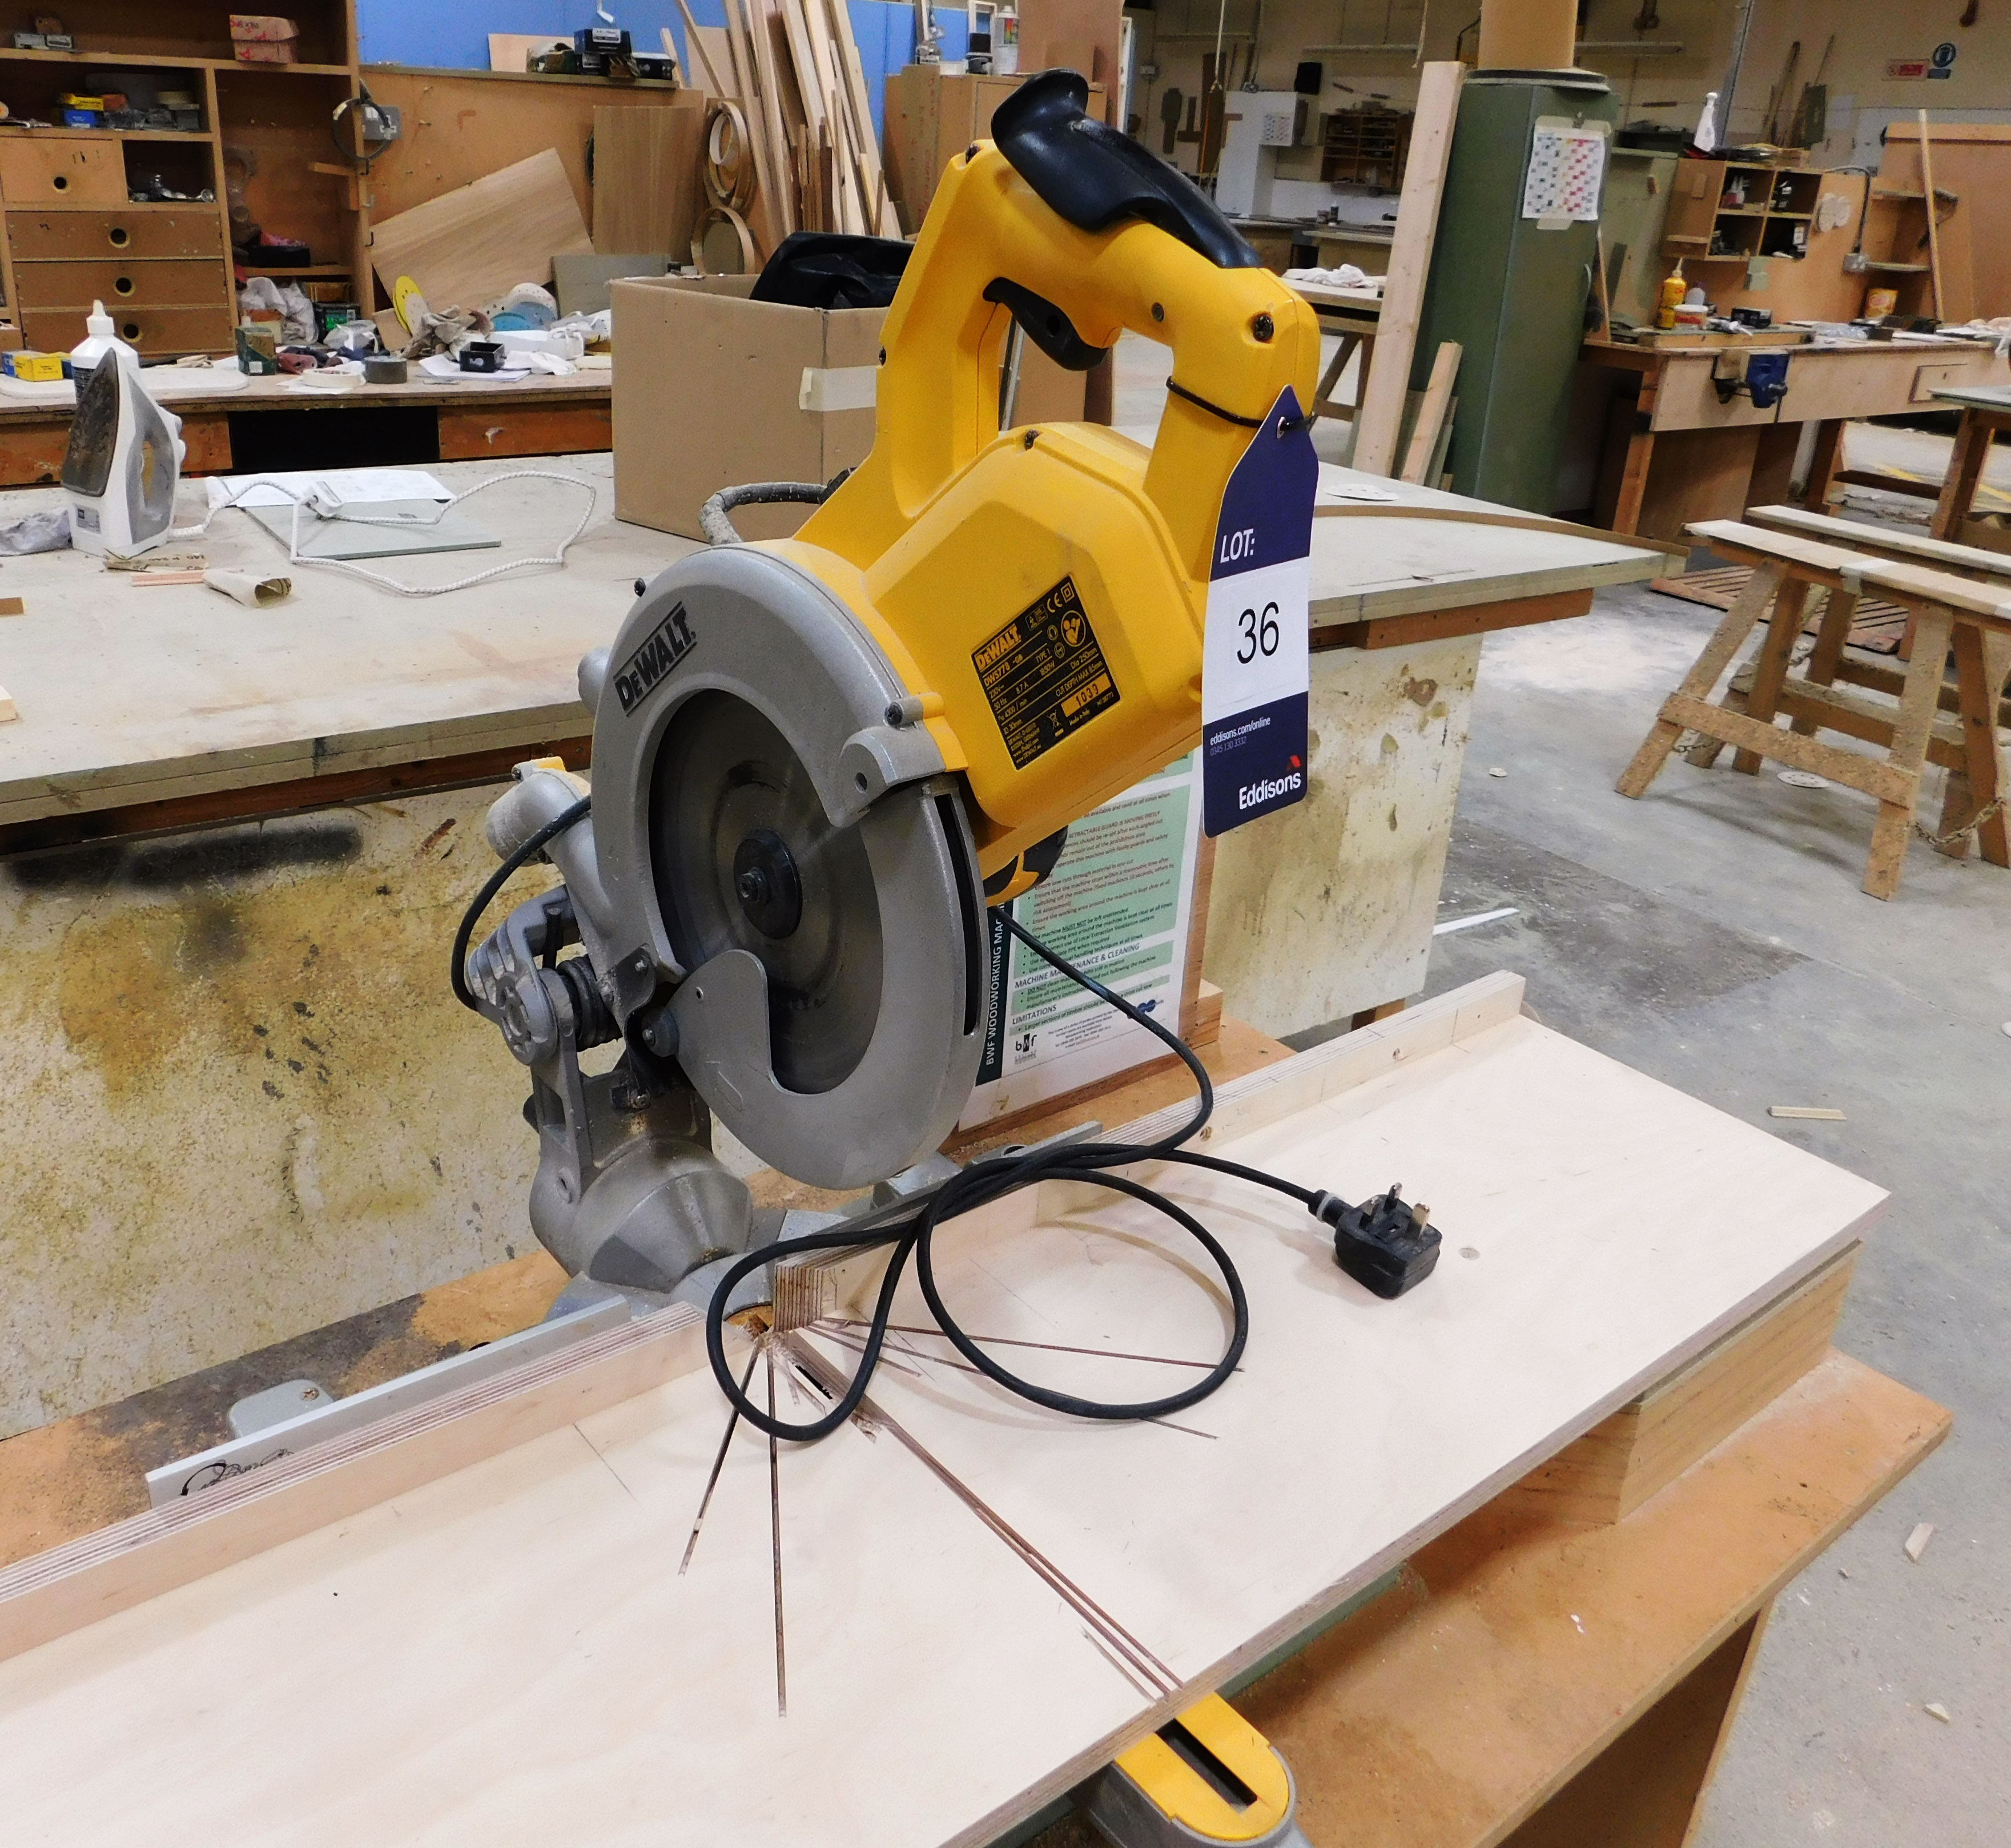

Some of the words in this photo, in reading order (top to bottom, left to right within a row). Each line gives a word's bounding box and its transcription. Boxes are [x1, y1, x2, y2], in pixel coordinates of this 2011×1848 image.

[1220, 528, 1255, 564] LOT:
[1237, 601, 1279, 664] 36
[1035, 650, 1047, 663] TYPE
[983, 661, 1010, 687] DWS778
[1055, 685, 1065, 698] CUT
[1064, 675, 1079, 691] DEPTH
[1077, 667, 1089, 681] MAX
[1022, 679, 1029, 689] A
[1003, 704, 1016, 718] 4300
[1210, 716, 1271, 746] eddisons.com/online
[1210, 744, 1223, 756] 0345
[1224, 741, 1234, 751] 130
[1239, 772, 1301, 810] Eddisons
[1068, 826, 1100, 838] RETRACTABLE
[1062, 923, 1075, 932] MUST
[1074, 948, 1093, 959] handling
[1015, 971, 1048, 989] MACHINE
[1050, 955, 1099, 977] MAENANCE
[1108, 942, 1139, 959] CLEANING
[987, 945, 1002, 1040] WOODWORKING
[1036, 983, 1046, 991] NOT
[1027, 992, 1042, 1002] Ensure
[1012, 1003, 1056, 1026] LIMITATIONS
[1024, 1020, 1040, 1032] Larger
[986, 1041, 995, 1066] BWF
